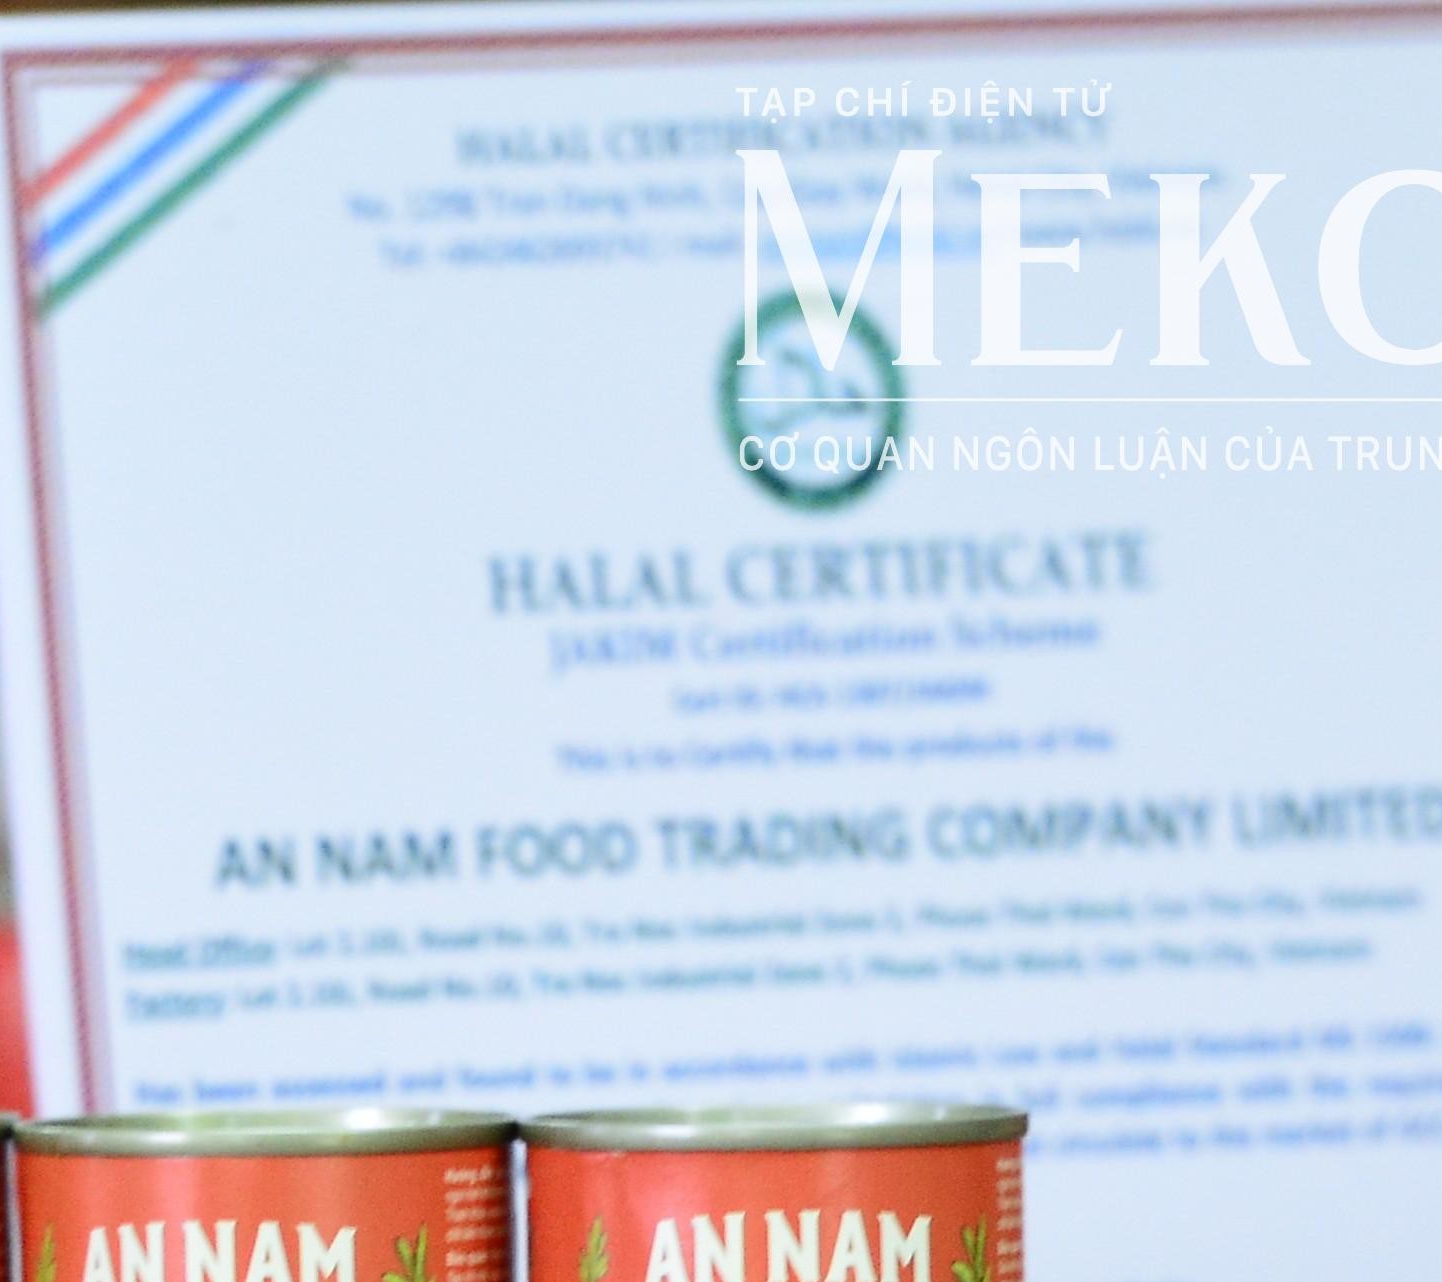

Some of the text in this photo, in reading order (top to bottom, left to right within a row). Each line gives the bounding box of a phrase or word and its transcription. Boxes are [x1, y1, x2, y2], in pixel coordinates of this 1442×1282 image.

[486, 529, 1155, 614] HALAL CERTIFICATE
[215, 836, 298, 888] AN
[316, 828, 458, 884] NAM
[477, 820, 638, 876] FOOD
[652, 808, 911, 868] TRADING
[925, 797, 1216, 860] COMPANY
